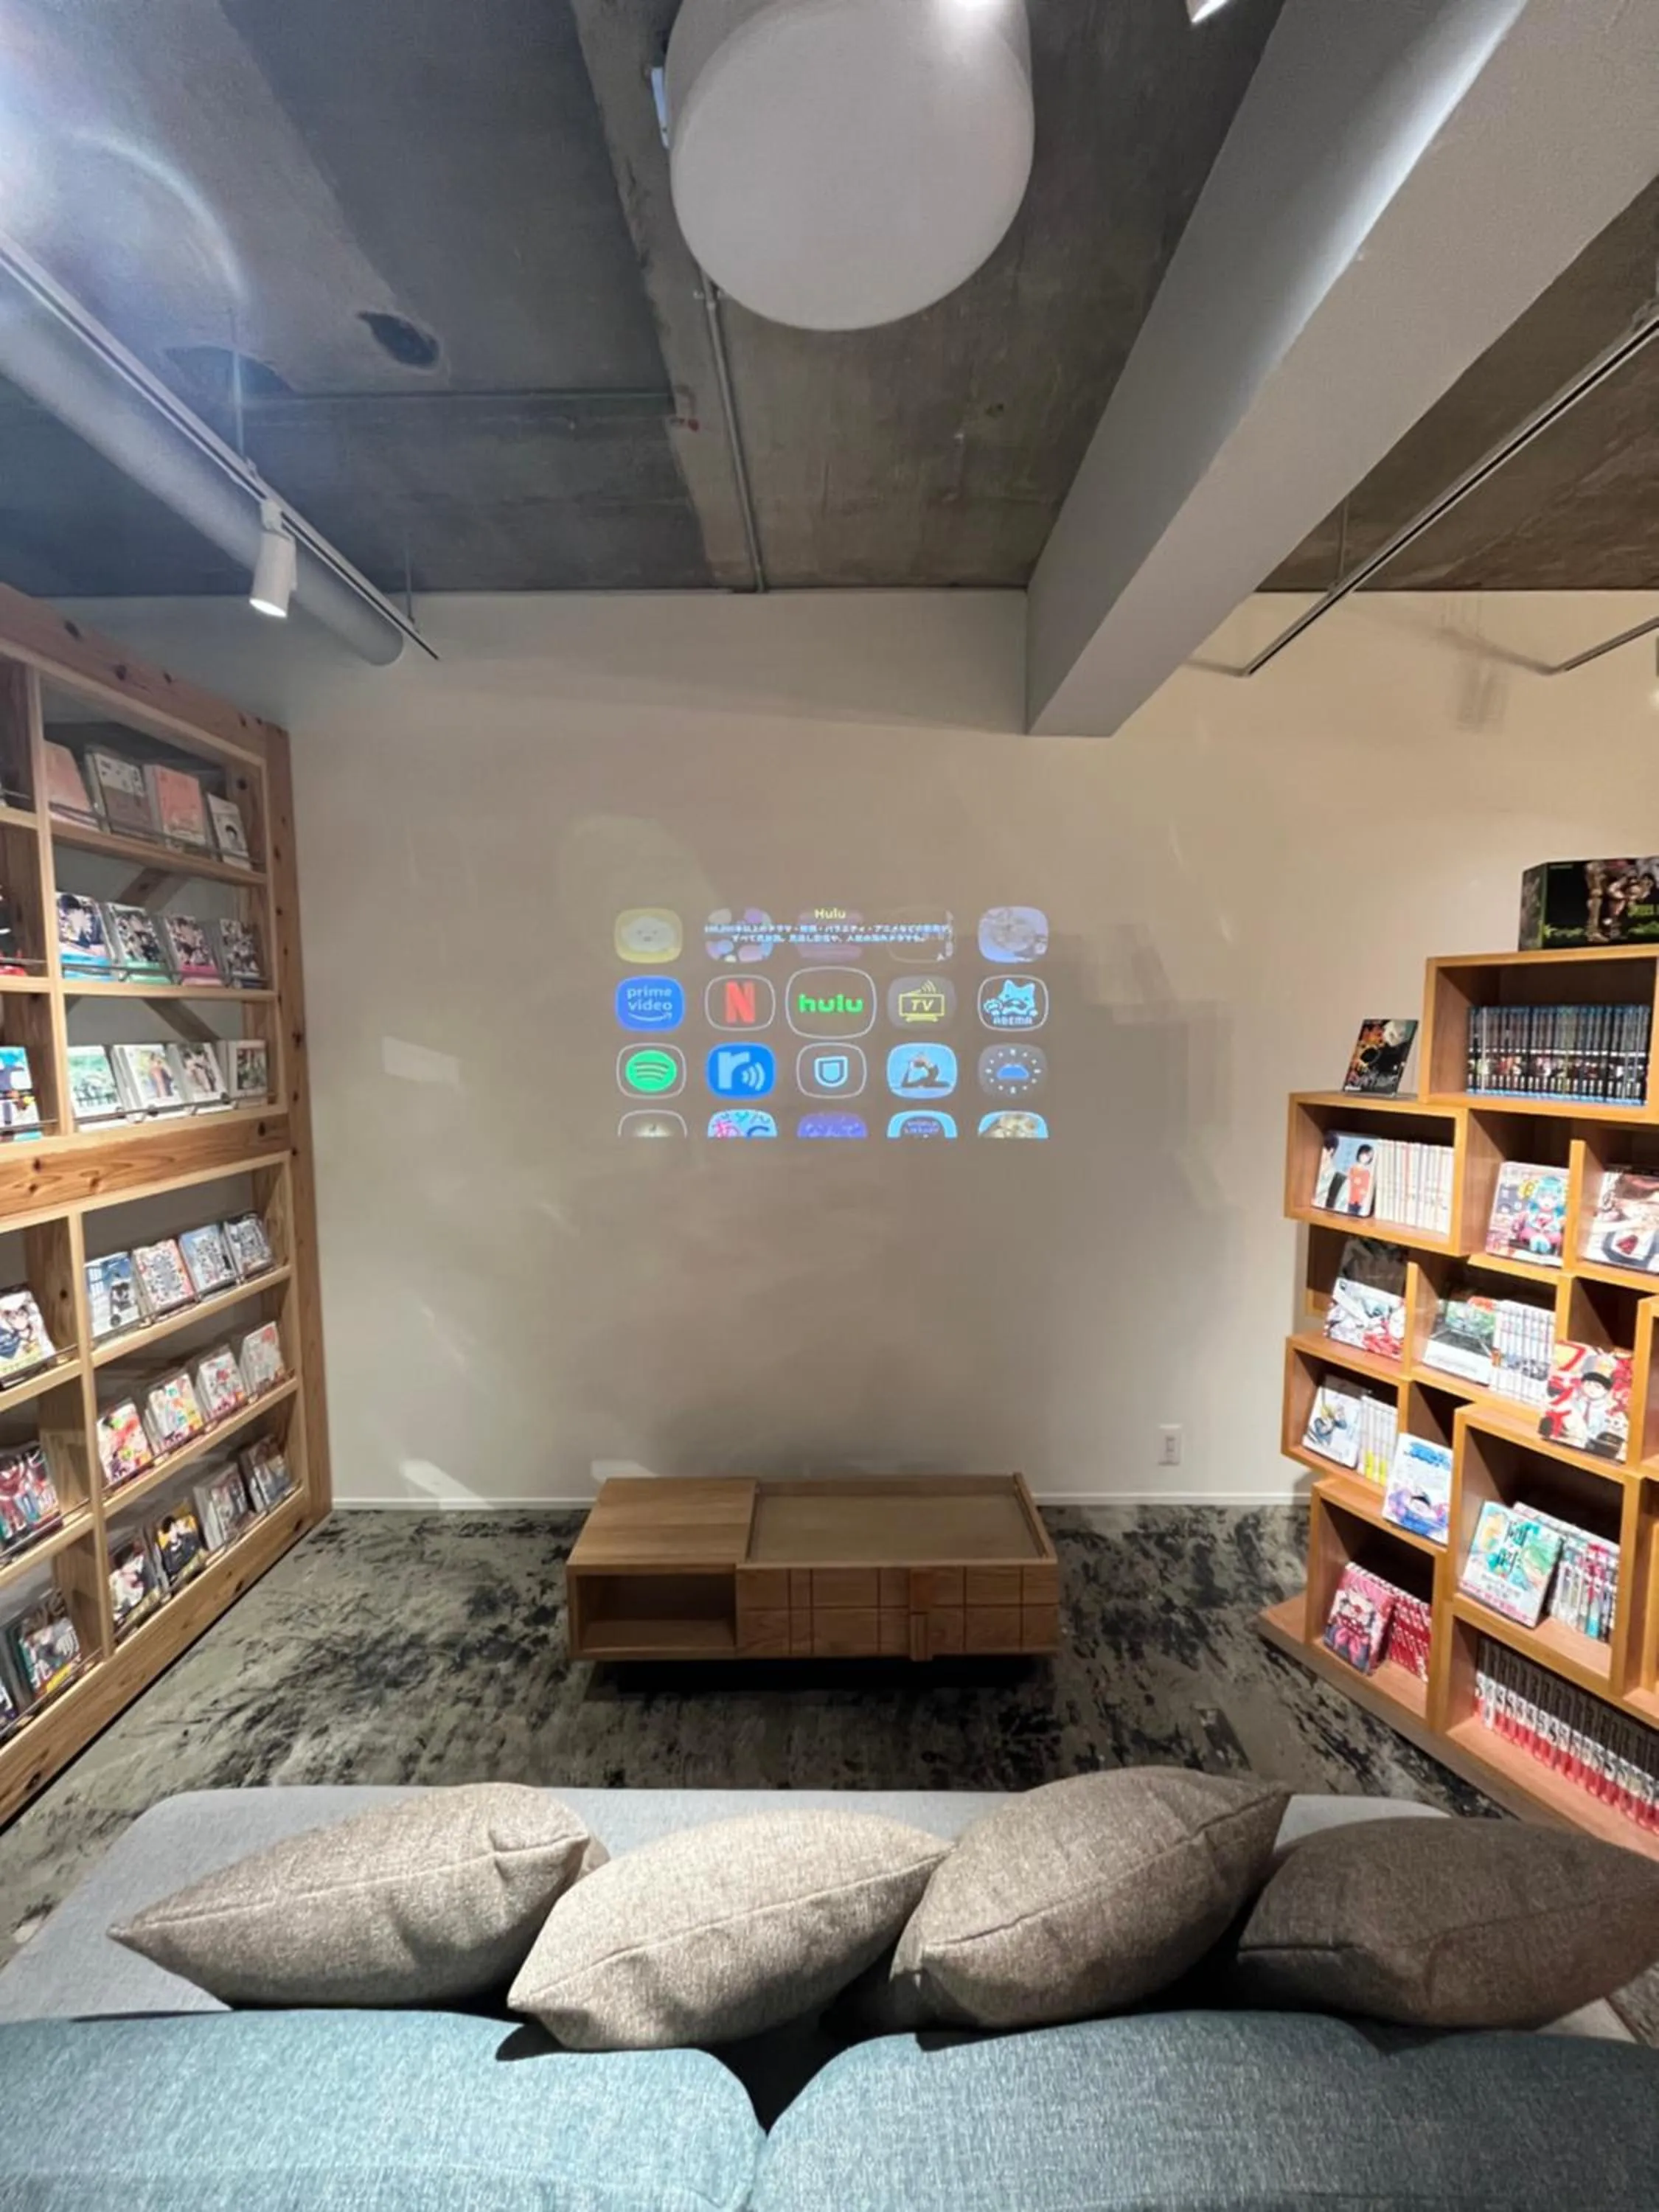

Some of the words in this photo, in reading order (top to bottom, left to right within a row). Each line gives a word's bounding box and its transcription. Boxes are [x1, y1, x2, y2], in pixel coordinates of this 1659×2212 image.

[813, 907, 846, 919] Hulu
[627, 985, 672, 999] prime
[627, 998, 672, 1012] video
[726, 980, 755, 1023] N
[799, 994, 863, 1013] hulu
[911, 999, 933, 1012] TV
